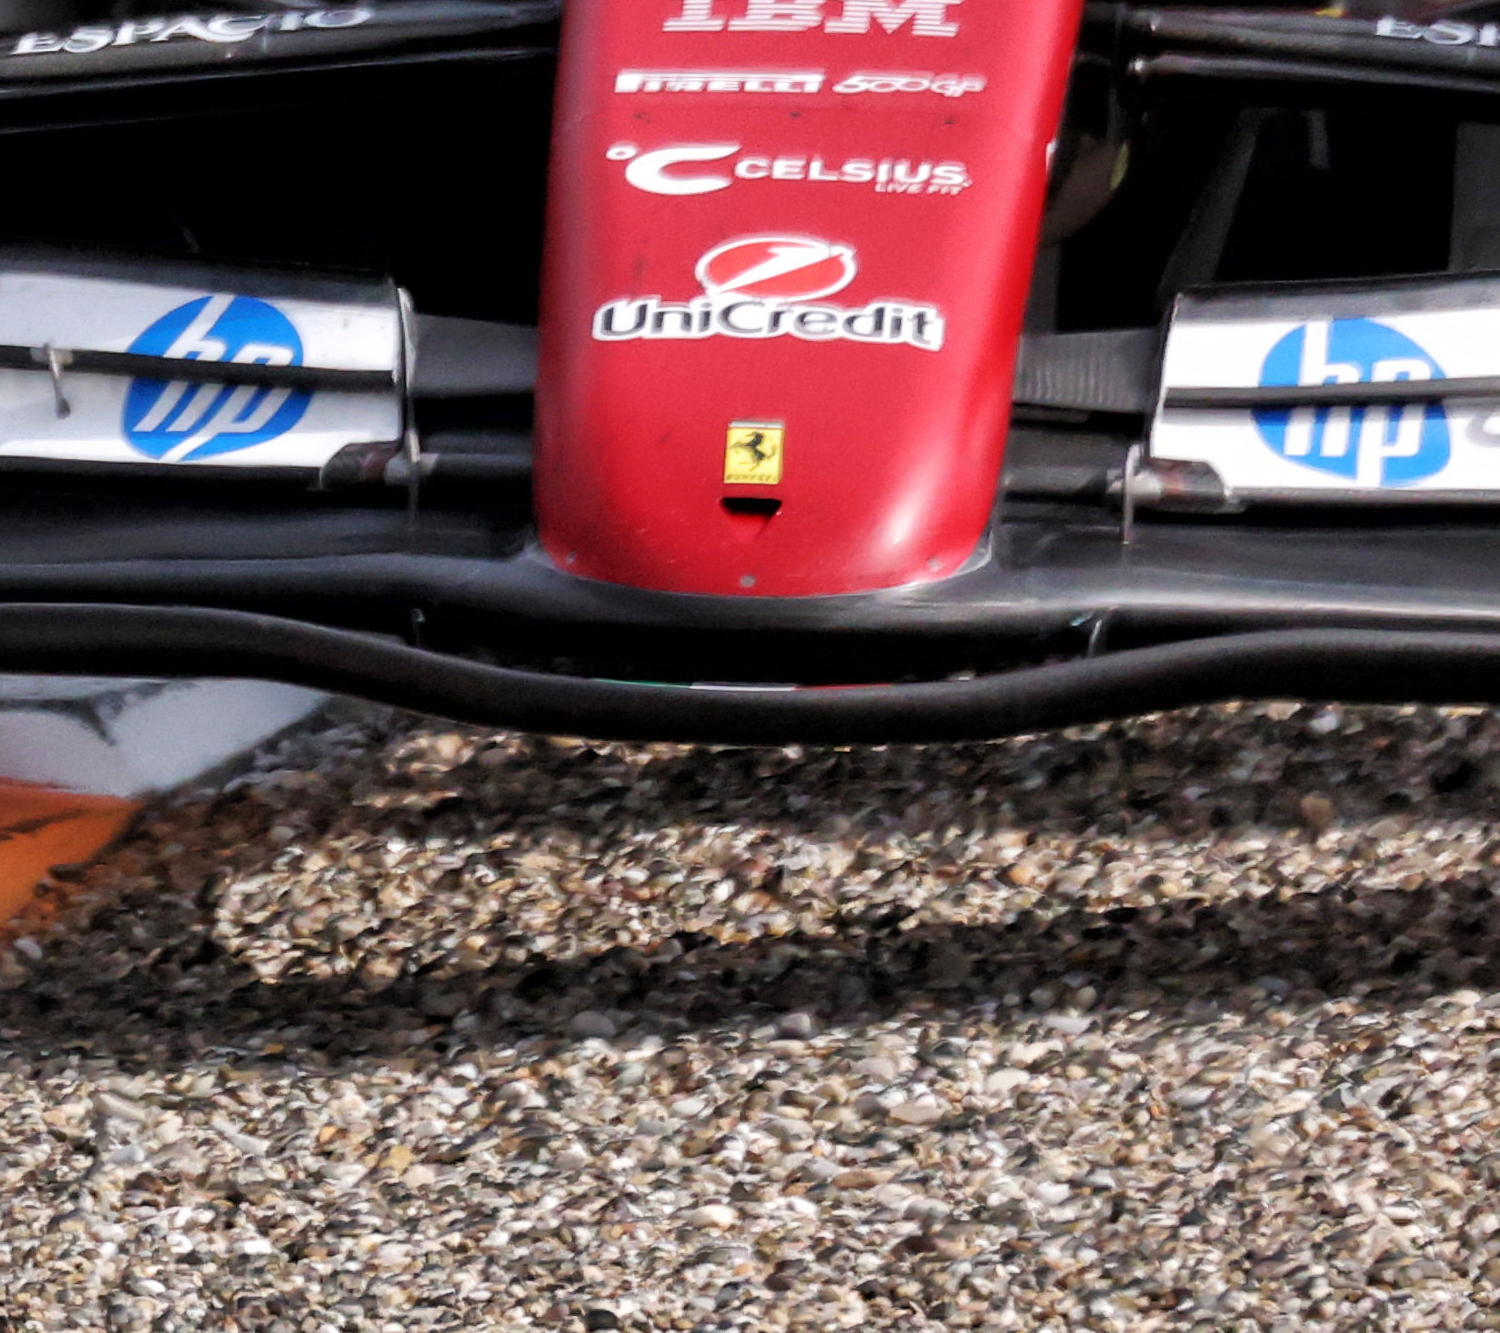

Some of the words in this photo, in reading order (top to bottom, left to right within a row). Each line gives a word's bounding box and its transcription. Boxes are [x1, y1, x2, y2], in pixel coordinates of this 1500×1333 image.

[615, 70, 826, 93] PIRELLI
[735, 158, 967, 185] CELSIUS
[599, 299, 935, 346] UniCredit
[133, 294, 297, 461] hp
[1283, 319, 1435, 486] hp
